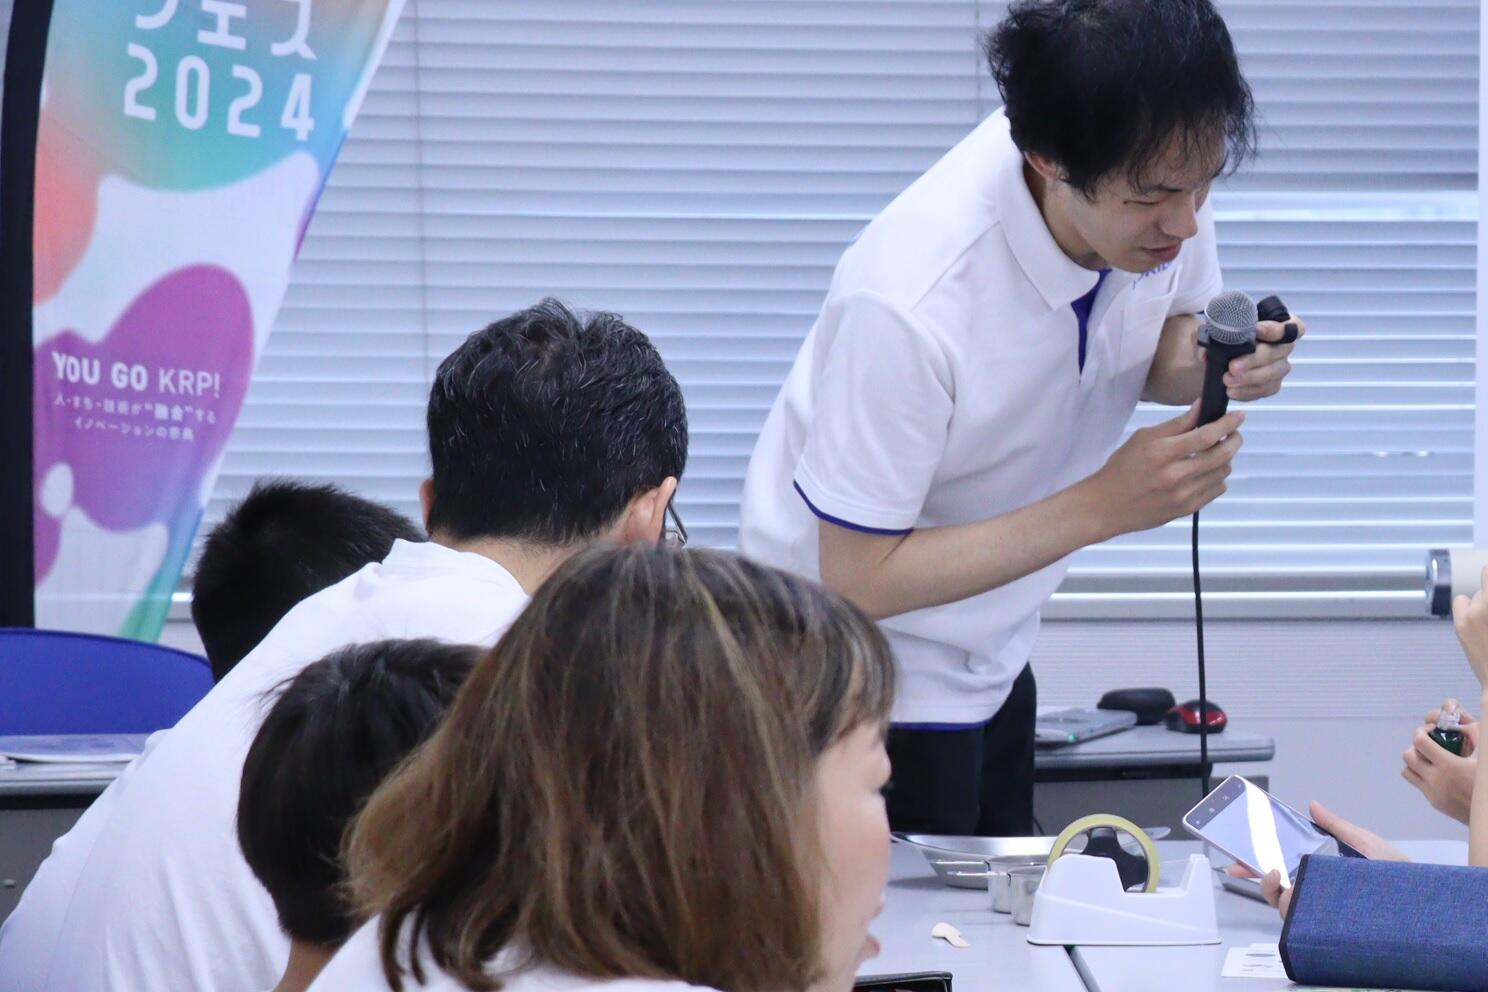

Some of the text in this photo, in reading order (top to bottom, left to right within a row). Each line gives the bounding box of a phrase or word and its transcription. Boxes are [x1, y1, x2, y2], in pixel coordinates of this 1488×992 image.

[124, 42, 315, 141] 2024
[51, 350, 221, 399] YOU GO KRP!
